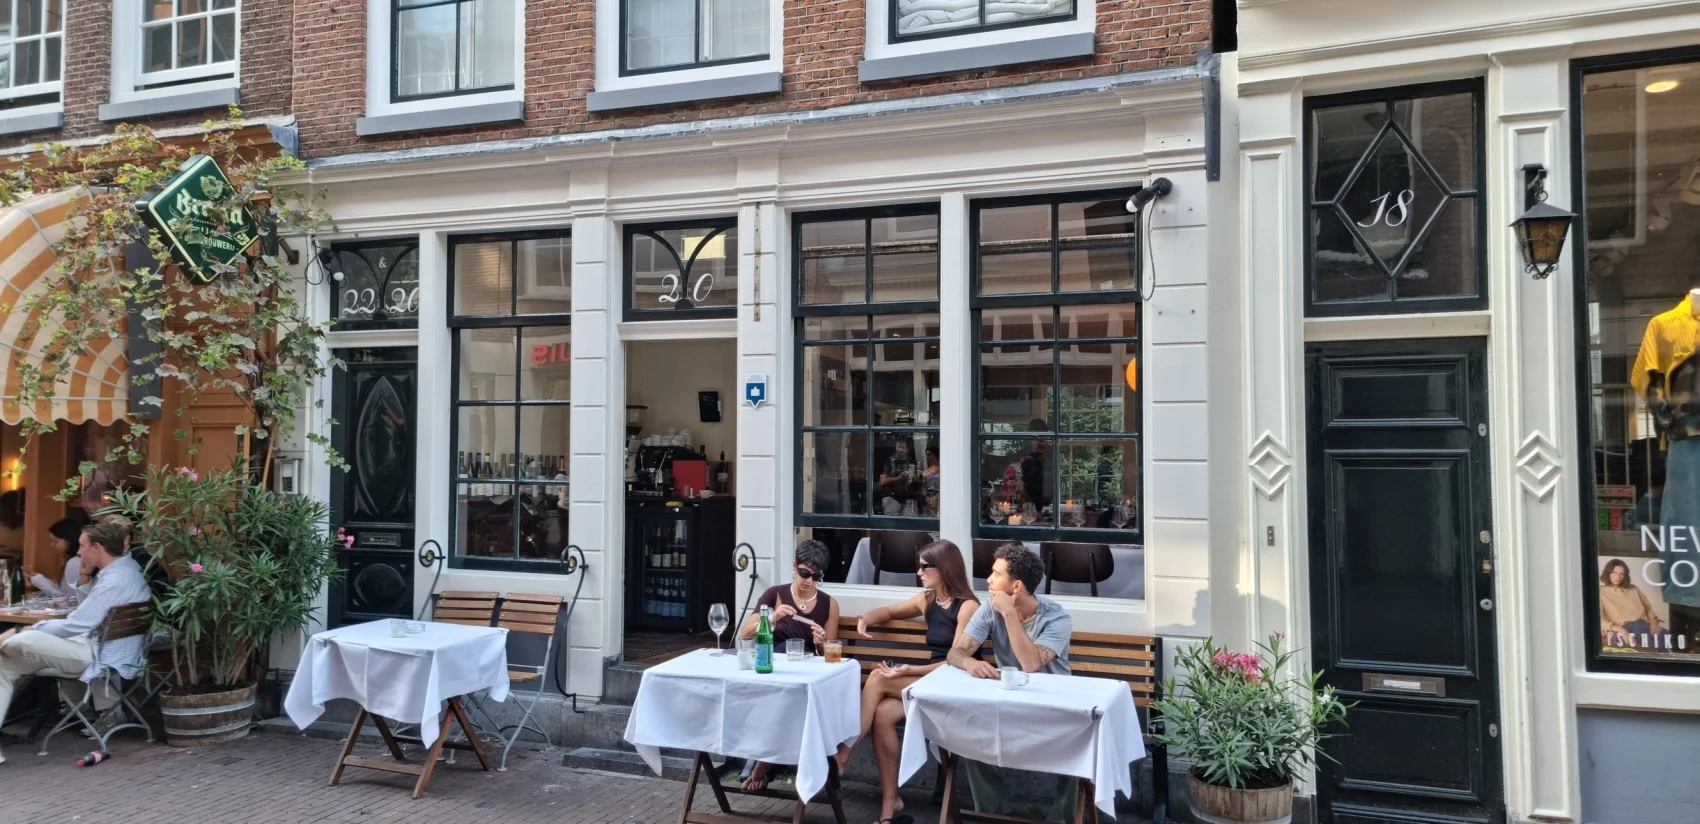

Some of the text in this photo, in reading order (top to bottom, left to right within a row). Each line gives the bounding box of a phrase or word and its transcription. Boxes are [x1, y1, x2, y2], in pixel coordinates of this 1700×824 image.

[1357, 190, 1414, 227] 18
[379, 257, 387, 268] &
[342, 288, 376, 314] 22
[658, 273, 714, 302] 20
[1642, 560, 1699, 588] CO
